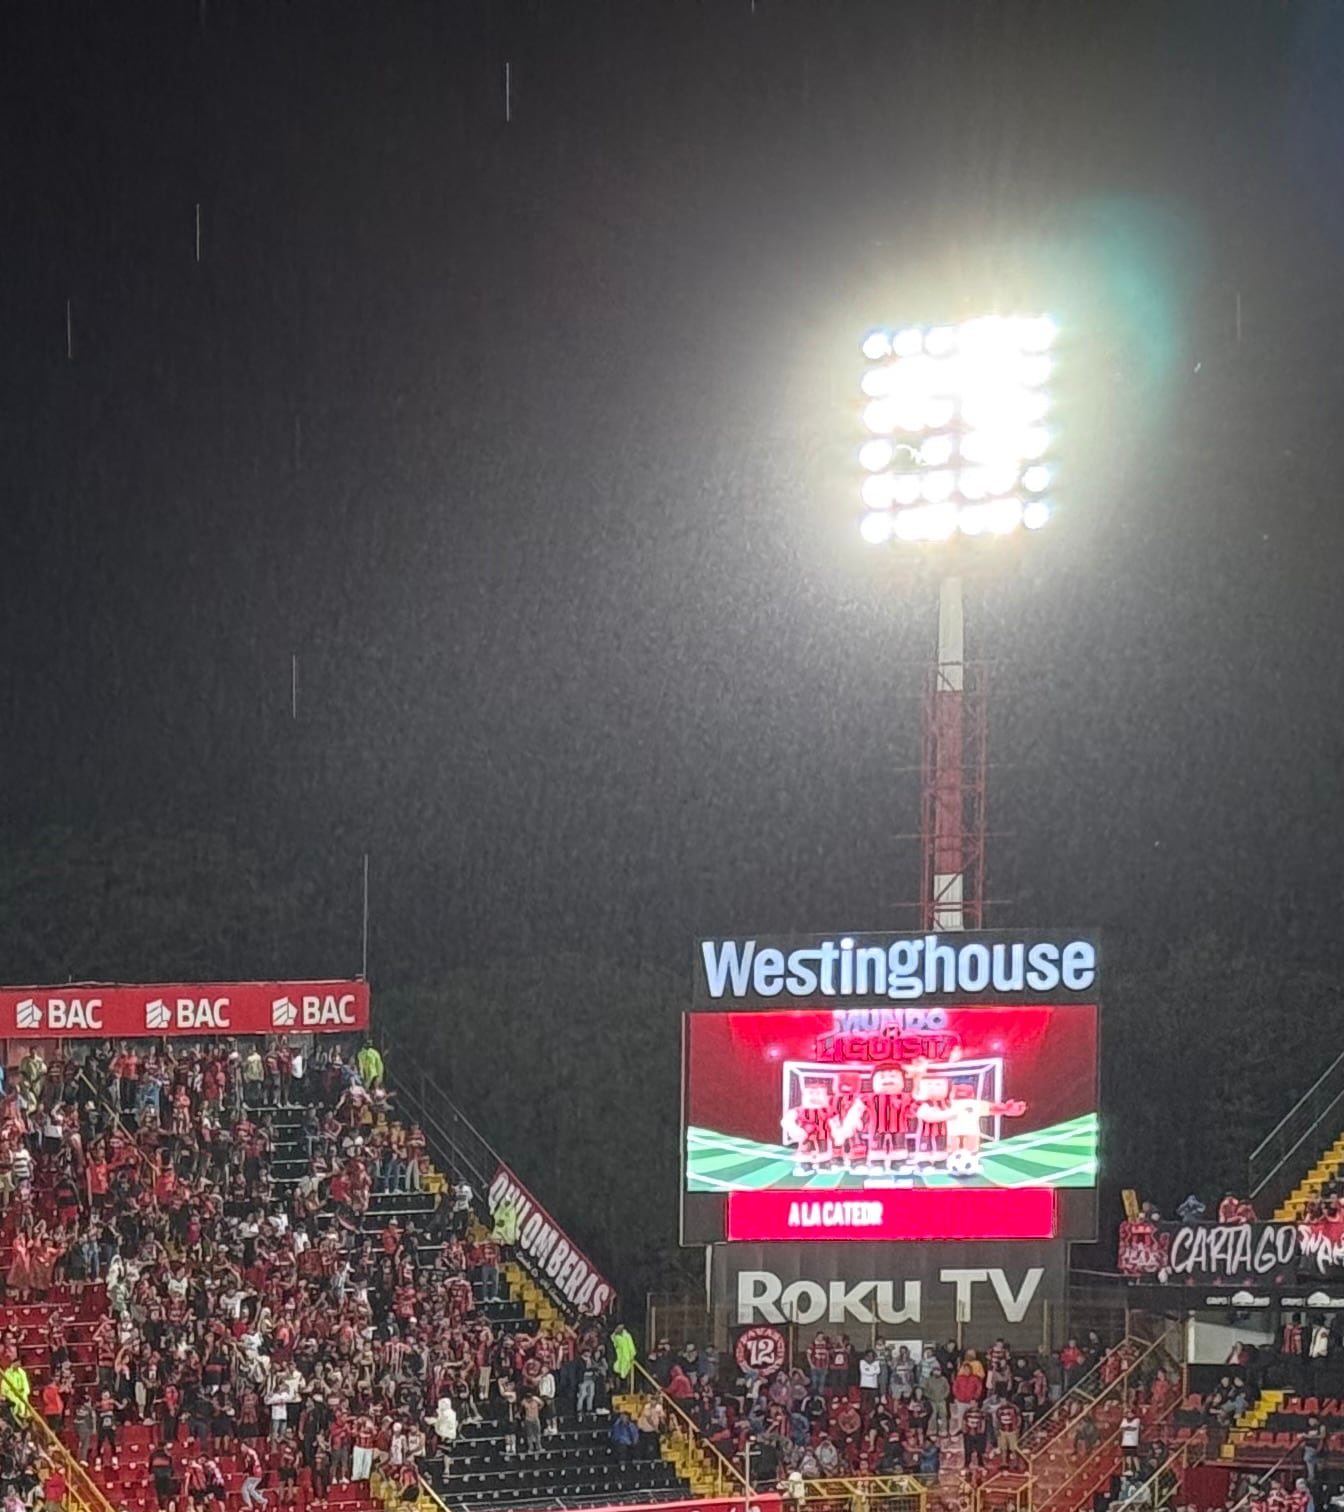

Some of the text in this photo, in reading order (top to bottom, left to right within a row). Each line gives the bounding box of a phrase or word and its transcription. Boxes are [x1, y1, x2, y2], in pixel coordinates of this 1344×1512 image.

[703, 936, 1097, 1000] Westinghouse
[48, 999, 103, 1029] BAC
[176, 998, 230, 1028] BAC
[302, 995, 355, 1025] BAC
[832, 1009, 948, 1031] MUNDO
[1170, 1225, 1297, 1275] CARTAGO
[738, 1268, 1046, 1325] Roku TV
[746, 1338, 775, 1366] 12
